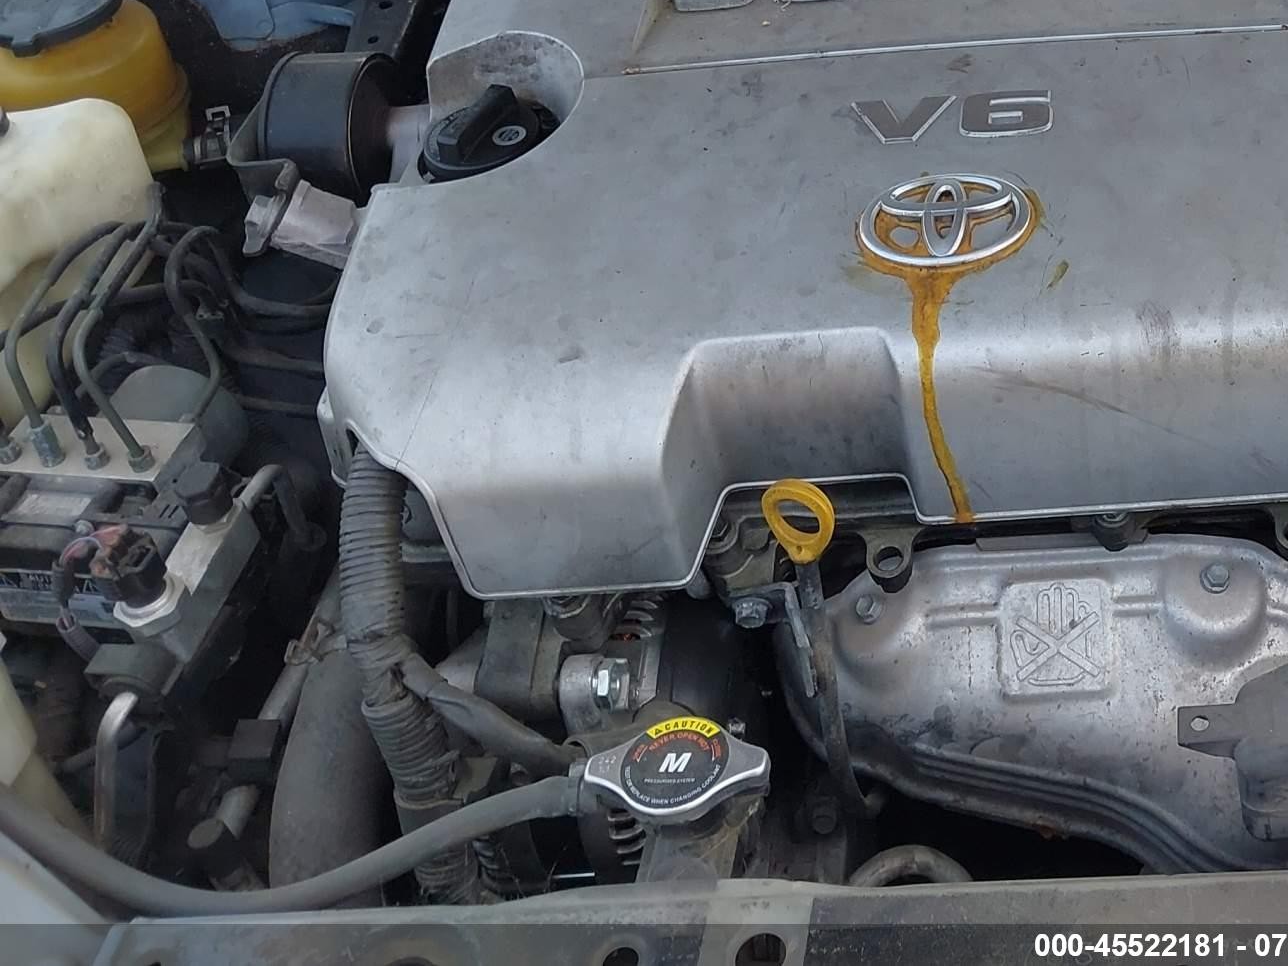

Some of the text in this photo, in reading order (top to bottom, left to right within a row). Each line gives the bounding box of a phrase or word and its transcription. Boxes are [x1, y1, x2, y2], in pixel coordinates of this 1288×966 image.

[851, 90, 1054, 144] V6
[664, 720, 713, 735] CAUTION
[658, 752, 692, 773] M
